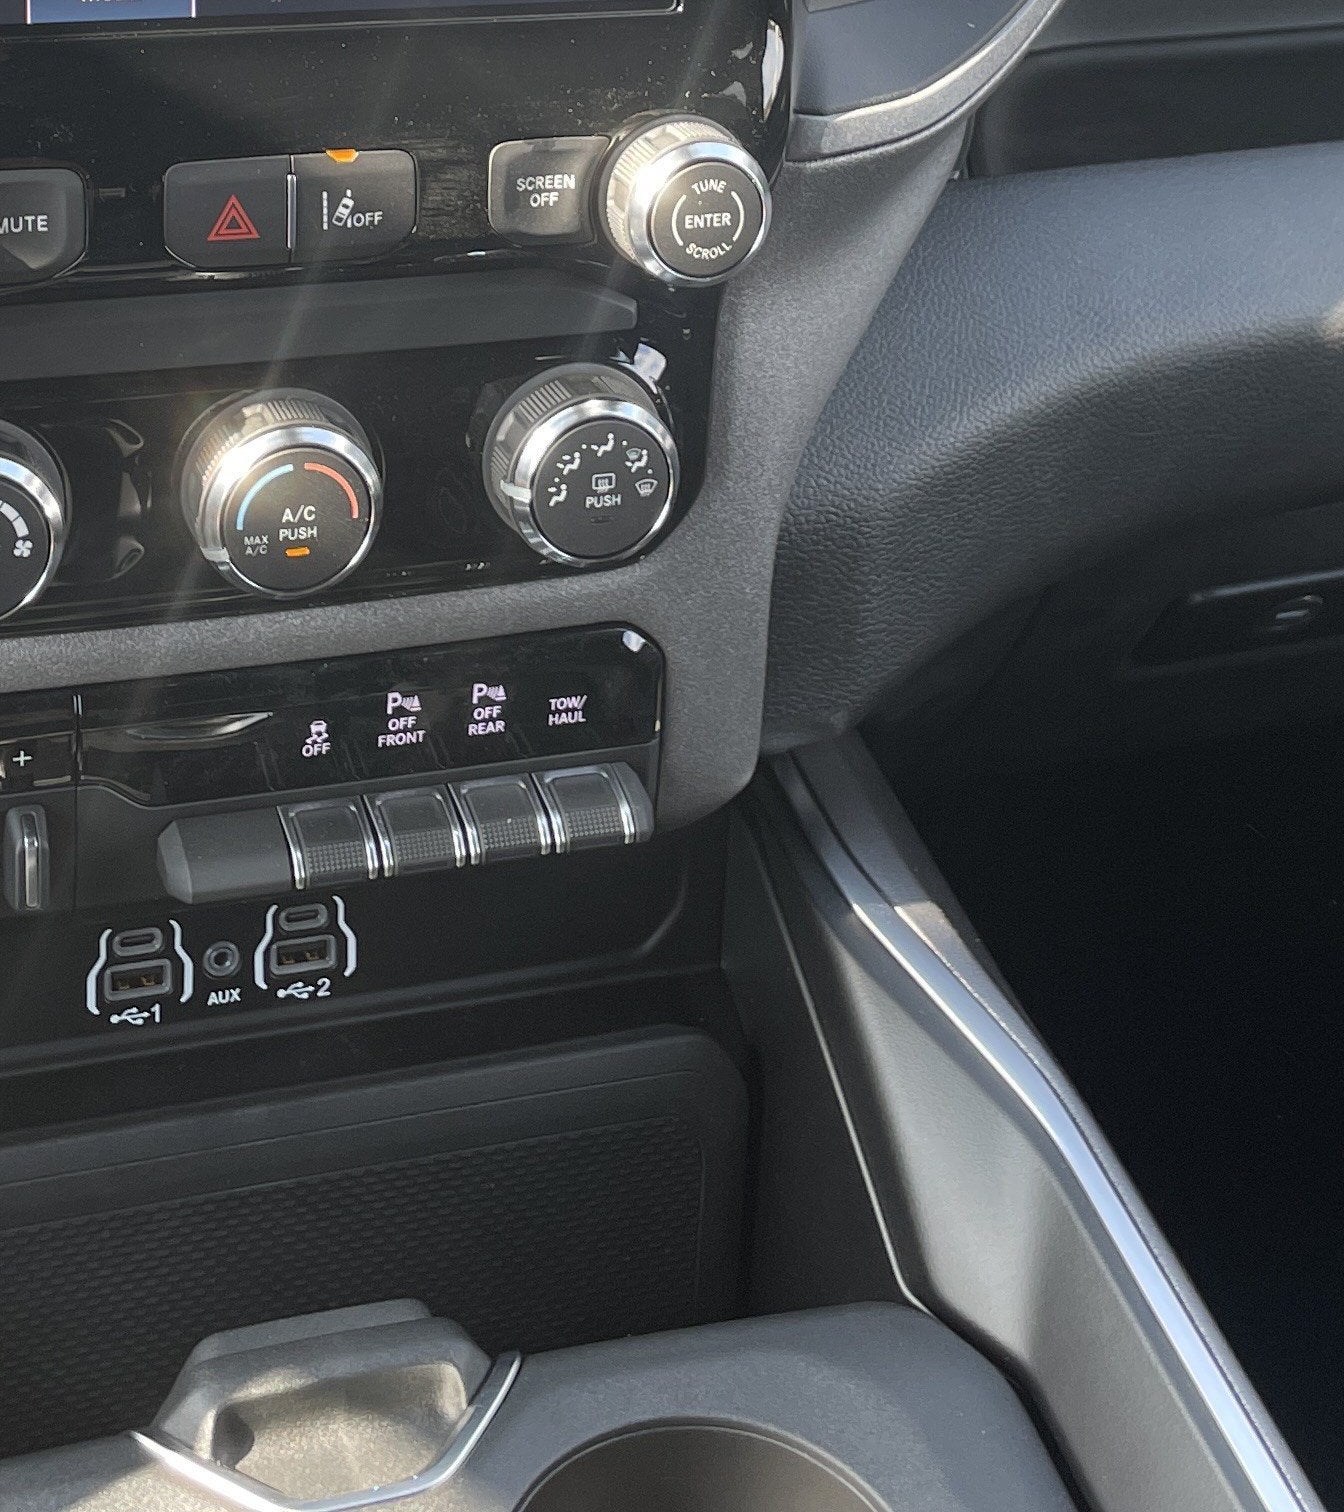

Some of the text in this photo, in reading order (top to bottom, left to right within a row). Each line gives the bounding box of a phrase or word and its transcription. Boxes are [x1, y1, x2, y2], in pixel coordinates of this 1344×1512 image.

[516, 174, 576, 191] SCREEN
[691, 178, 727, 196] TUNE
[529, 191, 559, 207] OFF
[353, 210, 383, 227] OFF
[684, 212, 732, 230] ENTER
[685, 240, 733, 261] SCROLL
[585, 493, 622, 510] PUSH
[281, 505, 316, 523] A/C
[243, 534, 269, 546] MAX
[278, 526, 318, 541] PUSH
[244, 544, 268, 556] A/C
[473, 705, 503, 720] OFF
[548, 710, 587, 727] HAUL
[387, 715, 417, 732] OFF
[468, 719, 506, 736] REAR
[377, 729, 427, 748] FRONT
[301, 741, 331, 758] OFF
[317, 978, 332, 997] 2
[206, 987, 242, 1006] AUX
[150, 1003, 161, 1023] 1
